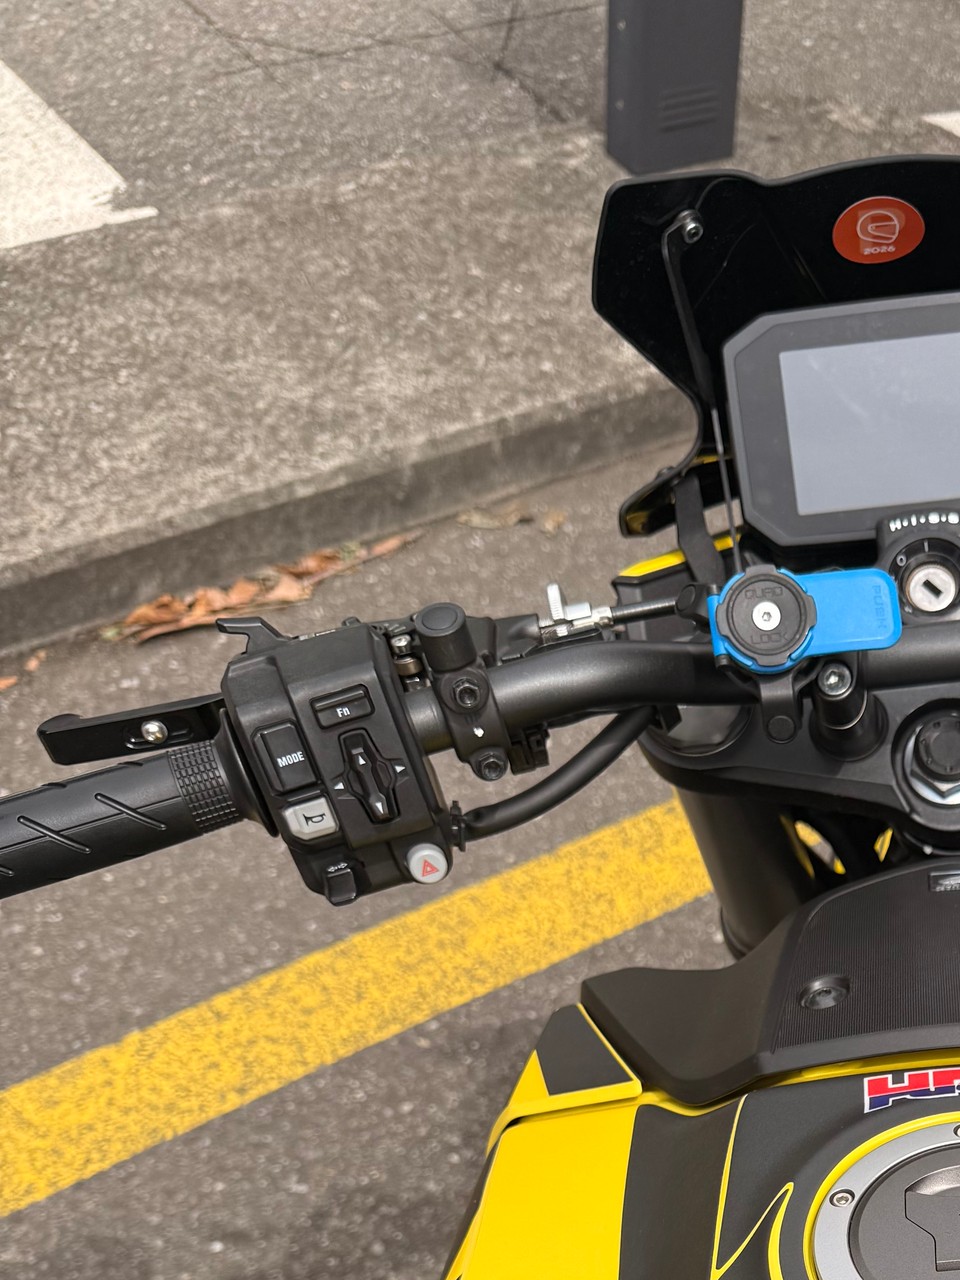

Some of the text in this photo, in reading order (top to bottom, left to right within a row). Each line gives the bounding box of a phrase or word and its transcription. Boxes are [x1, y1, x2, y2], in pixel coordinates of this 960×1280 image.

[864, 245, 896, 255] 2026
[744, 586, 783, 600] QUAD
[750, 632, 789, 645] LOCK
[336, 706, 351, 718] Fn
[276, 751, 305, 767] MODE
